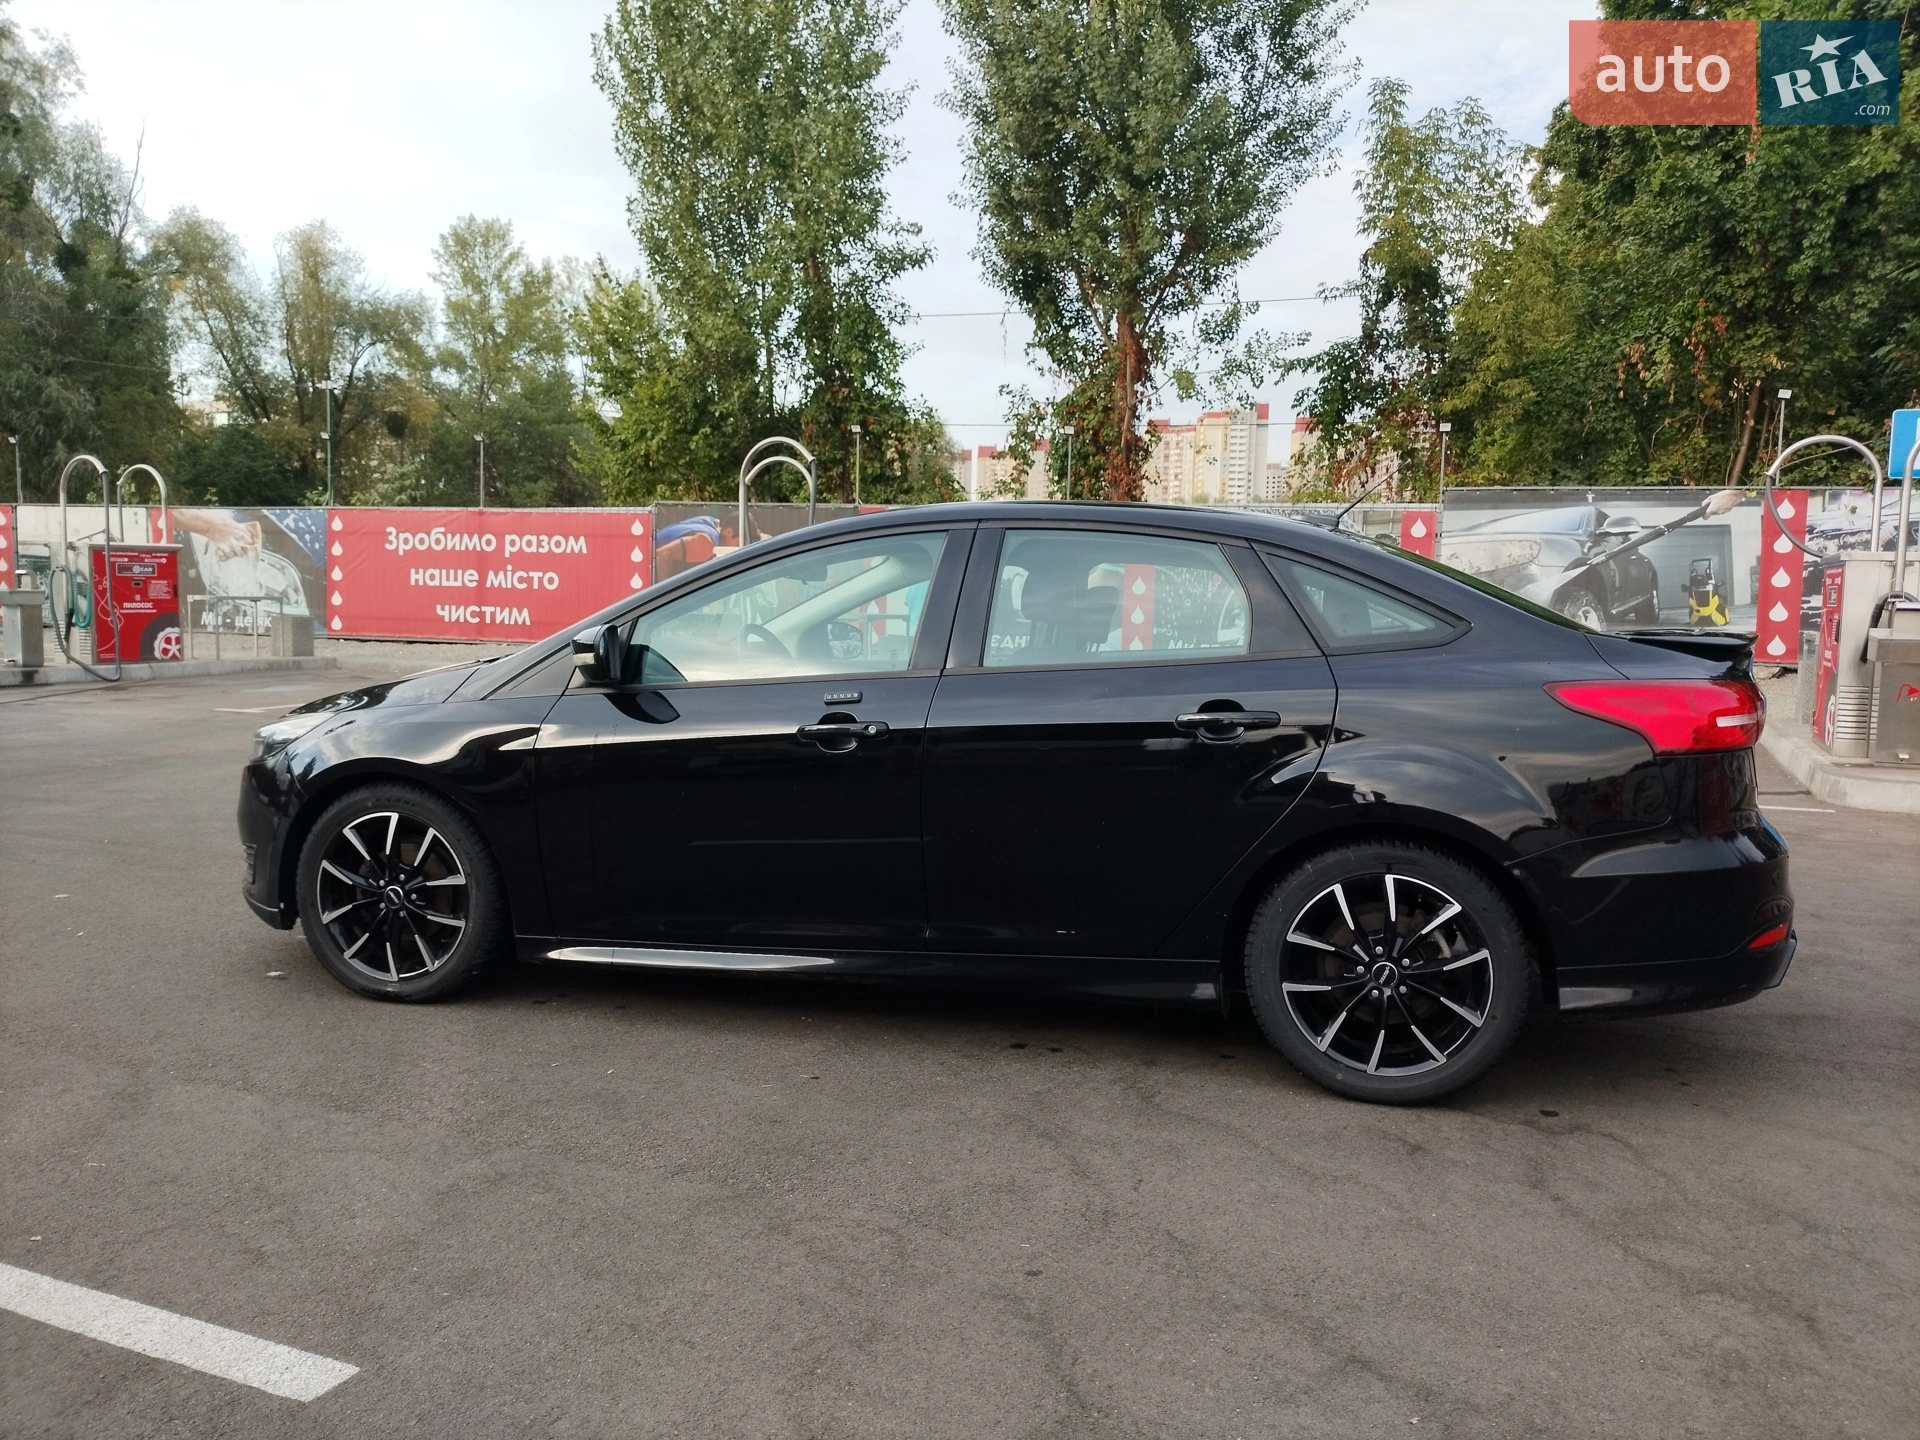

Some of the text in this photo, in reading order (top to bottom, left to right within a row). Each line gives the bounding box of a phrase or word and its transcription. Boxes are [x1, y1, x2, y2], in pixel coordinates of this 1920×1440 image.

[384, 526, 588, 558] Зробимо разом
[410, 564, 560, 590] наше місто
[435, 604, 531, 626] чистим
